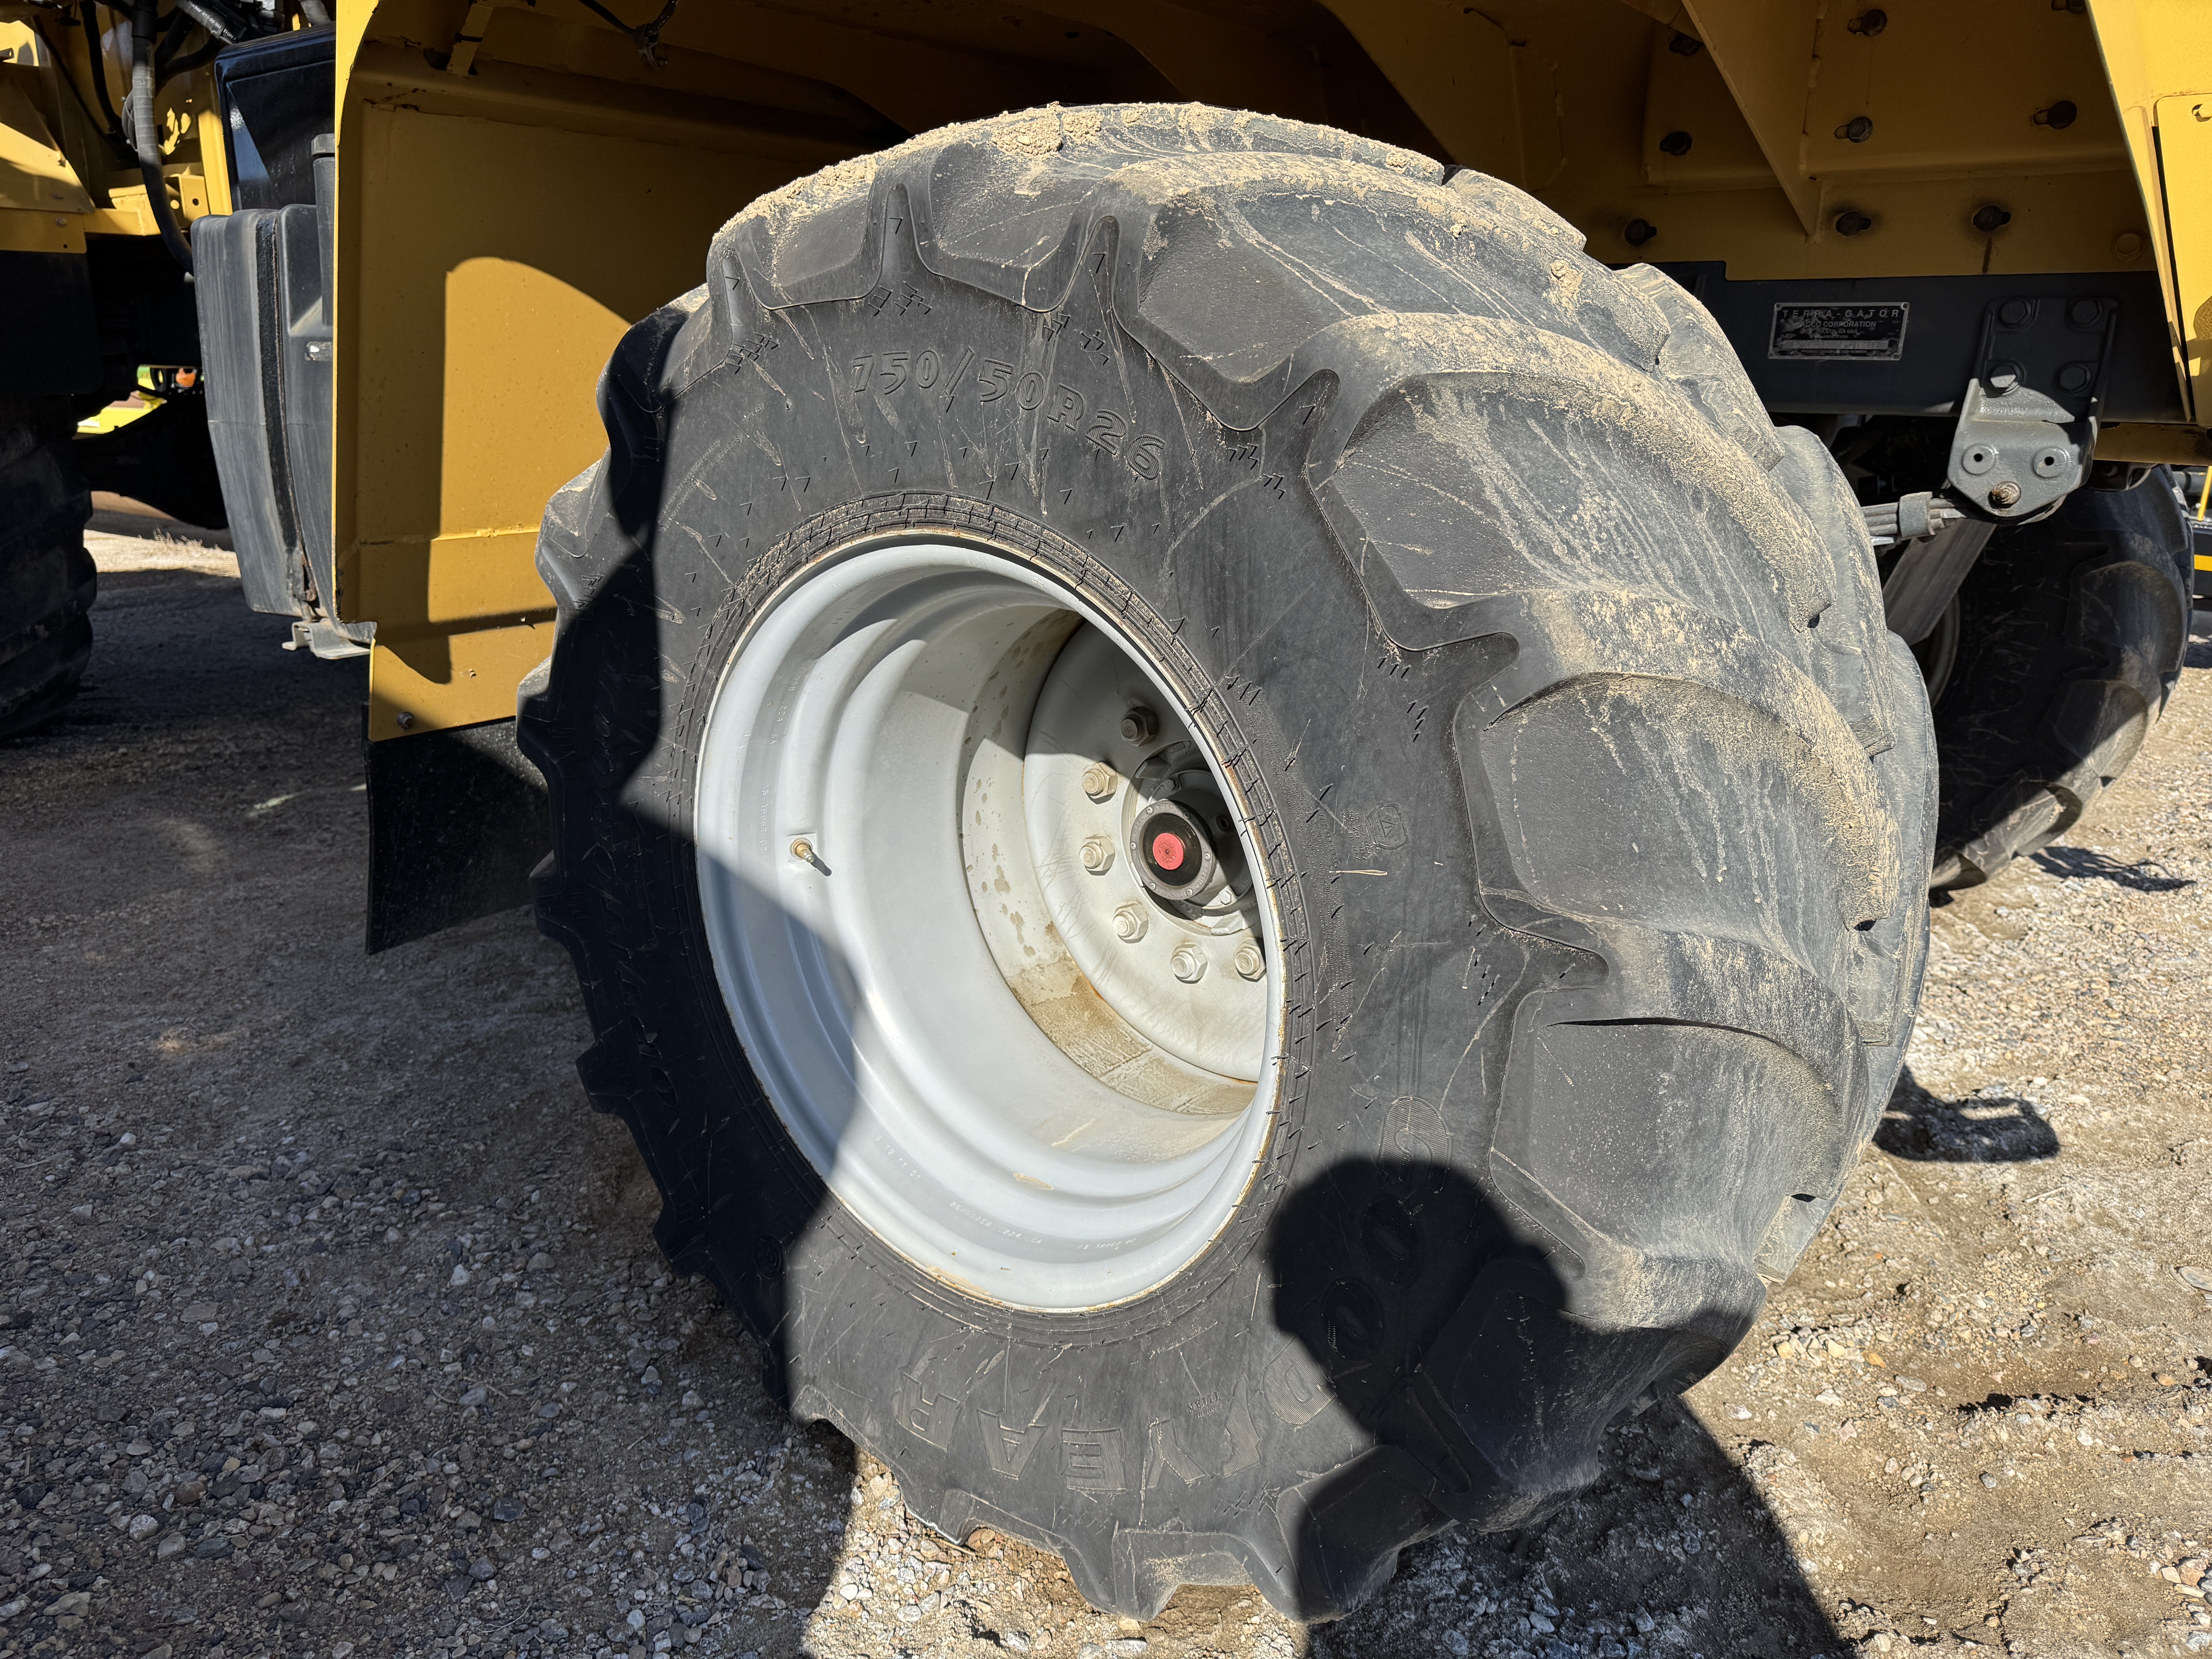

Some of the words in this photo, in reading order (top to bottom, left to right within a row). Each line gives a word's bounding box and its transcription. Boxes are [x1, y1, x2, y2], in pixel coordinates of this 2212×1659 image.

[1782, 309, 1899, 318] TERRA-GATOR
[852, 345, 1166, 480] 750/50R26
[759, 803, 768, 832] 19967
[1317, 812, 1342, 868] WARNING
[1352, 826, 1361, 841] KPA
[1358, 824, 1366, 836] PSI
[760, 840, 766, 852] 02
[892, 1095, 1453, 1491] GOODYEAR
